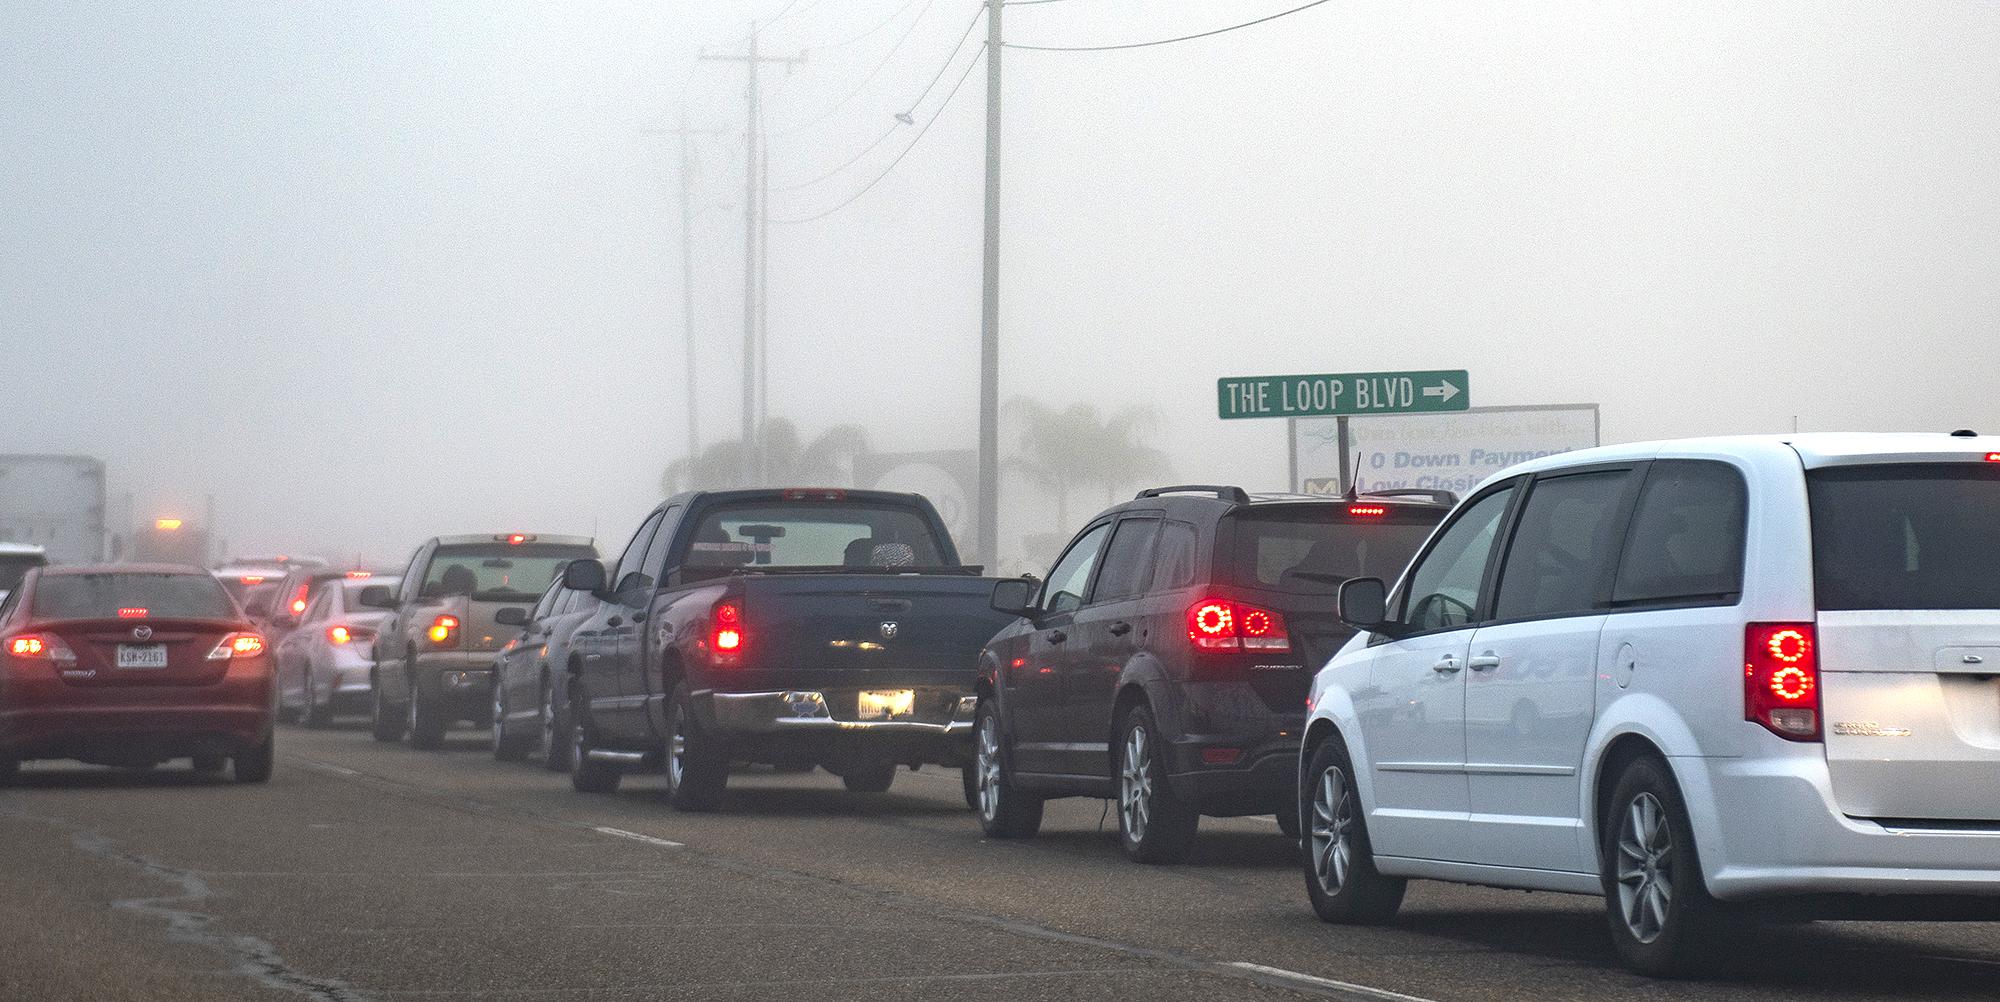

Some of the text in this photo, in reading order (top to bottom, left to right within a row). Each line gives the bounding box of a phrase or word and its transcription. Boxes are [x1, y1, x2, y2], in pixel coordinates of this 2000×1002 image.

[1227, 376, 1414, 413] THE LOOP BLVD
[1394, 451, 1460, 468] Down
[1358, 477, 1407, 493] Low
